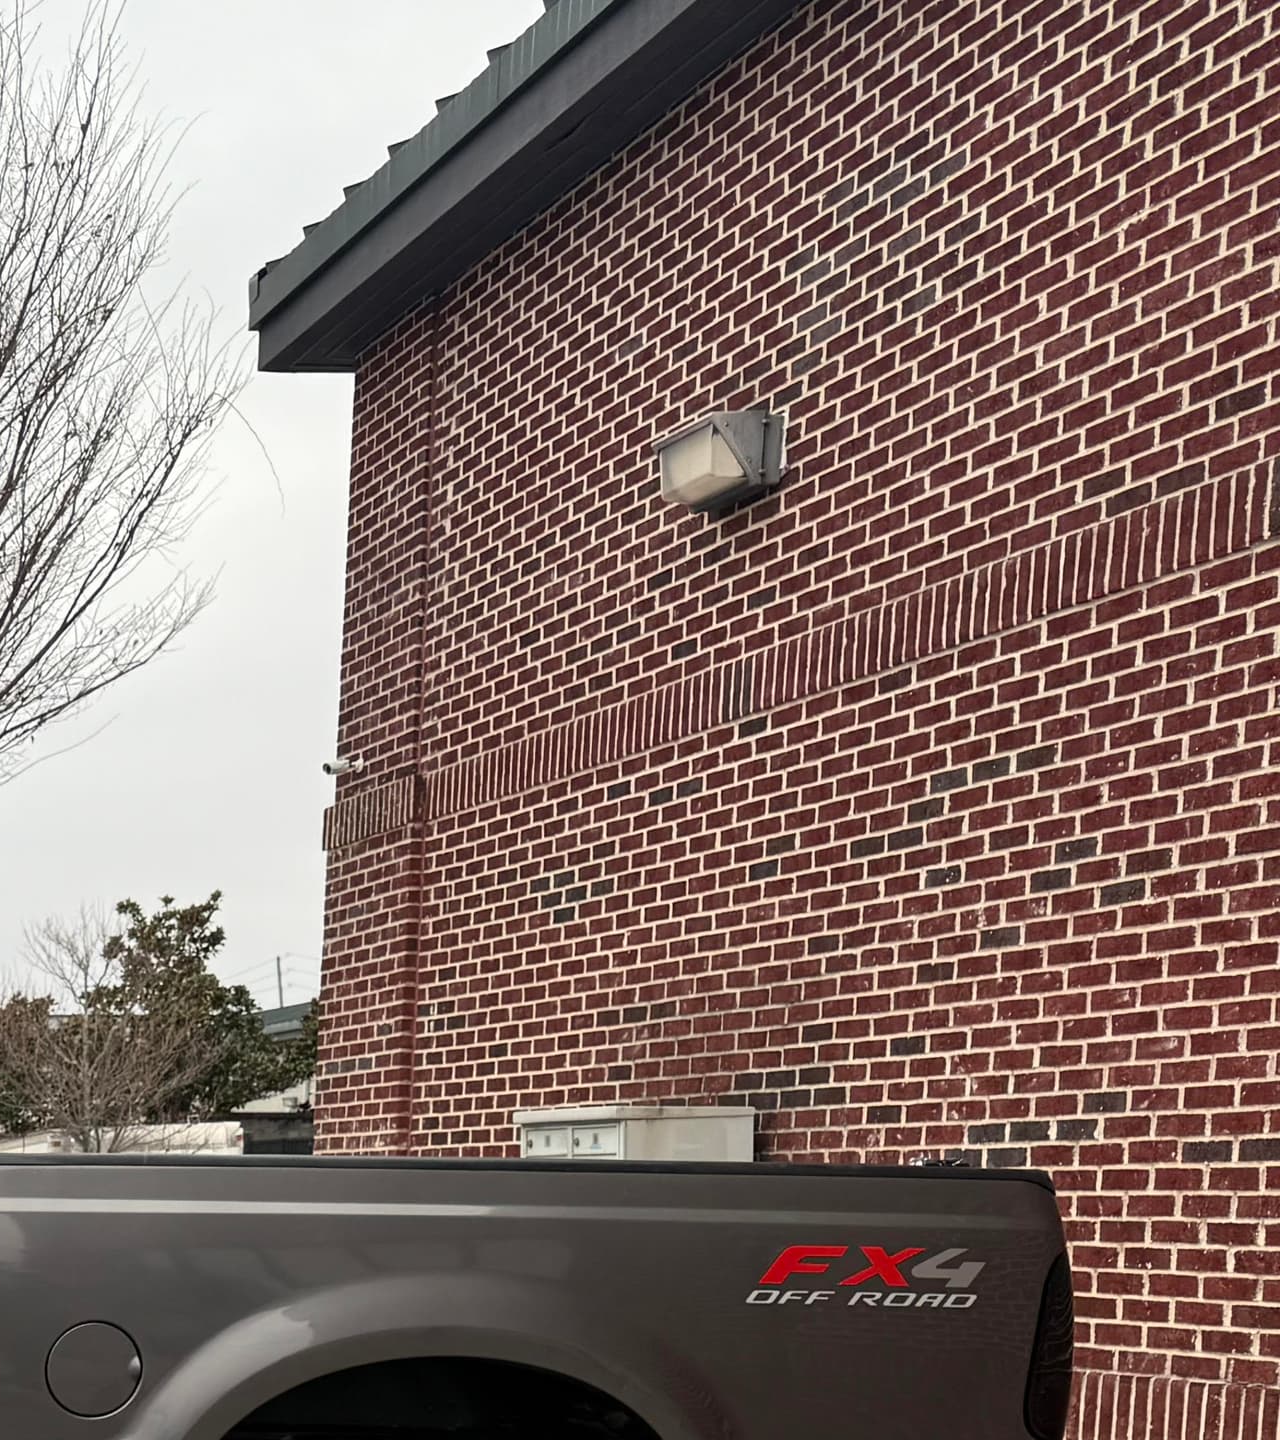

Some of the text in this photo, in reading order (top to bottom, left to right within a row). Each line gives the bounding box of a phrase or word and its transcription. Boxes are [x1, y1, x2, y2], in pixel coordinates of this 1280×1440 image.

[758, 1244, 987, 1288] FX4
[745, 1289, 978, 1309] OFF ROAD
